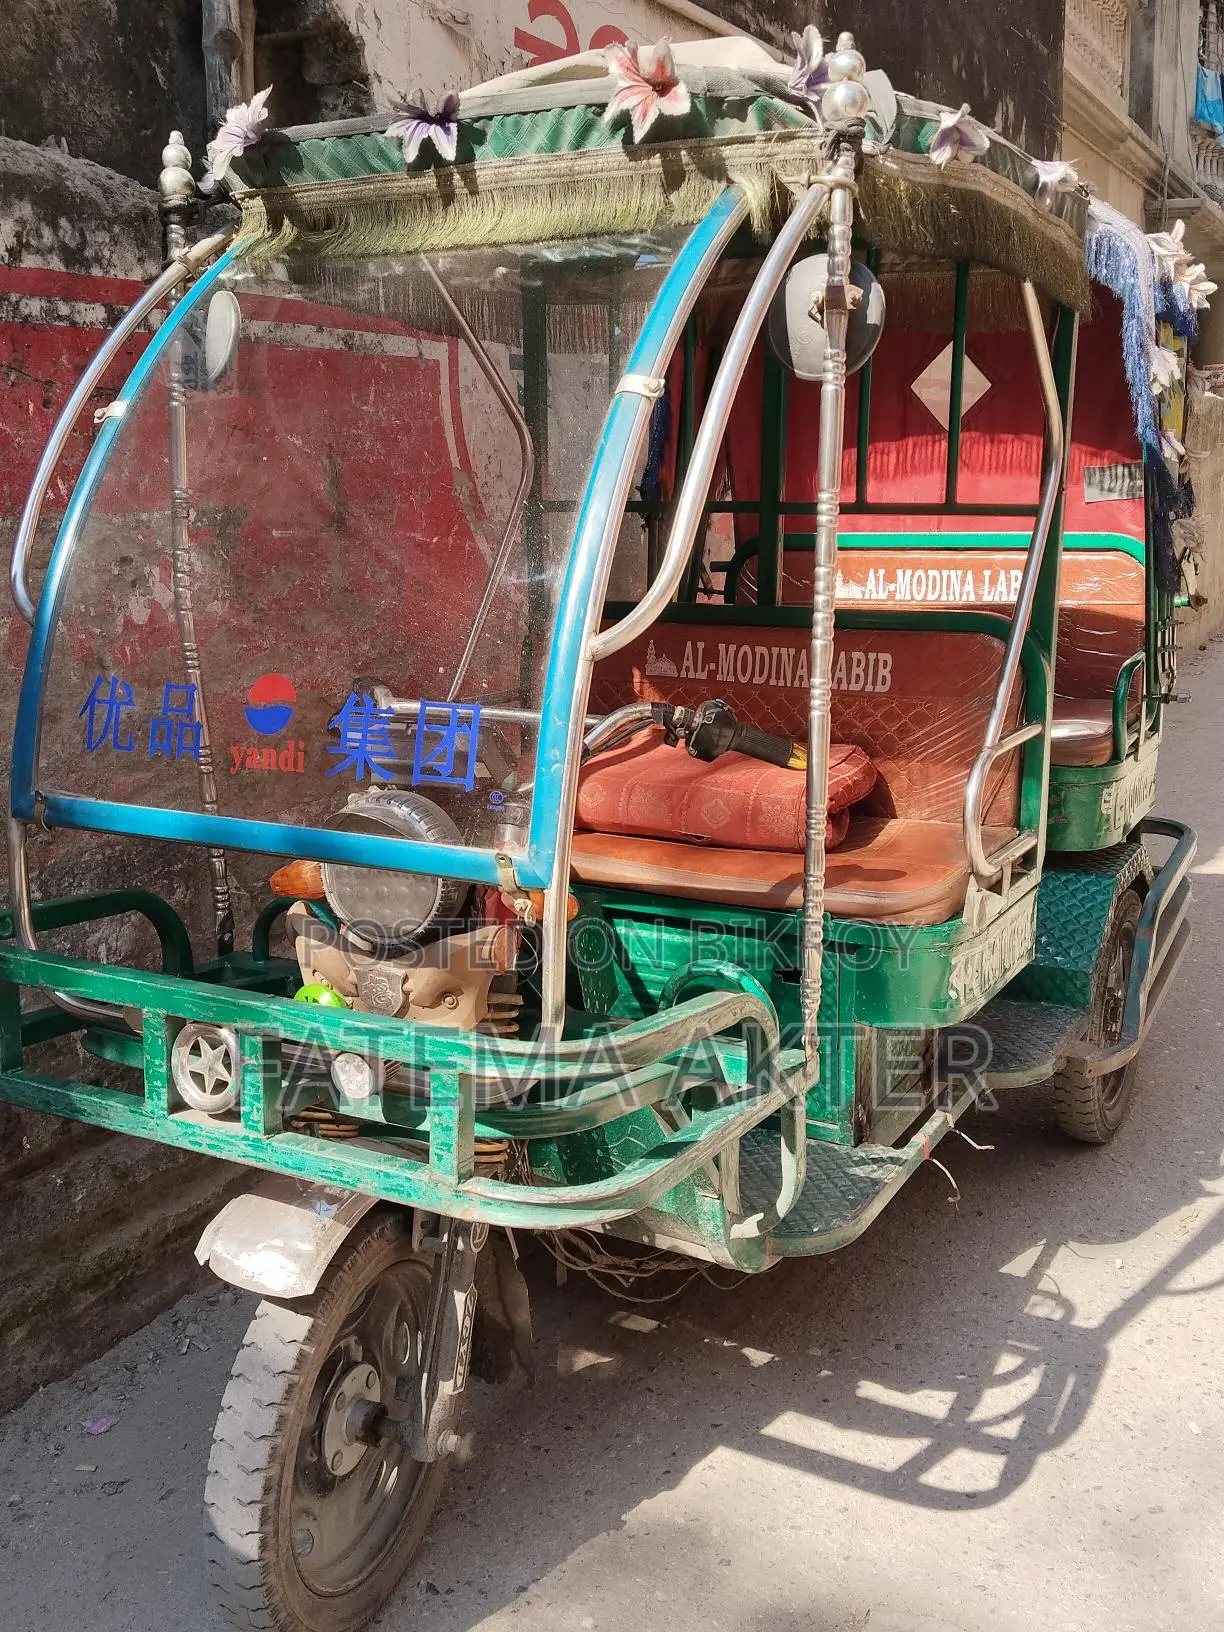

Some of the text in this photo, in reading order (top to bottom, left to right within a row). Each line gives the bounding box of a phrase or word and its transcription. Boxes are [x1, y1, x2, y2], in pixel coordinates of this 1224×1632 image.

[864, 568, 1023, 601] AL-MODINA LAB
[680, 640, 893, 693] AL-MODINA ABIB
[79, 674, 482, 792] 优品 集团
[231, 739, 305, 774] yandi
